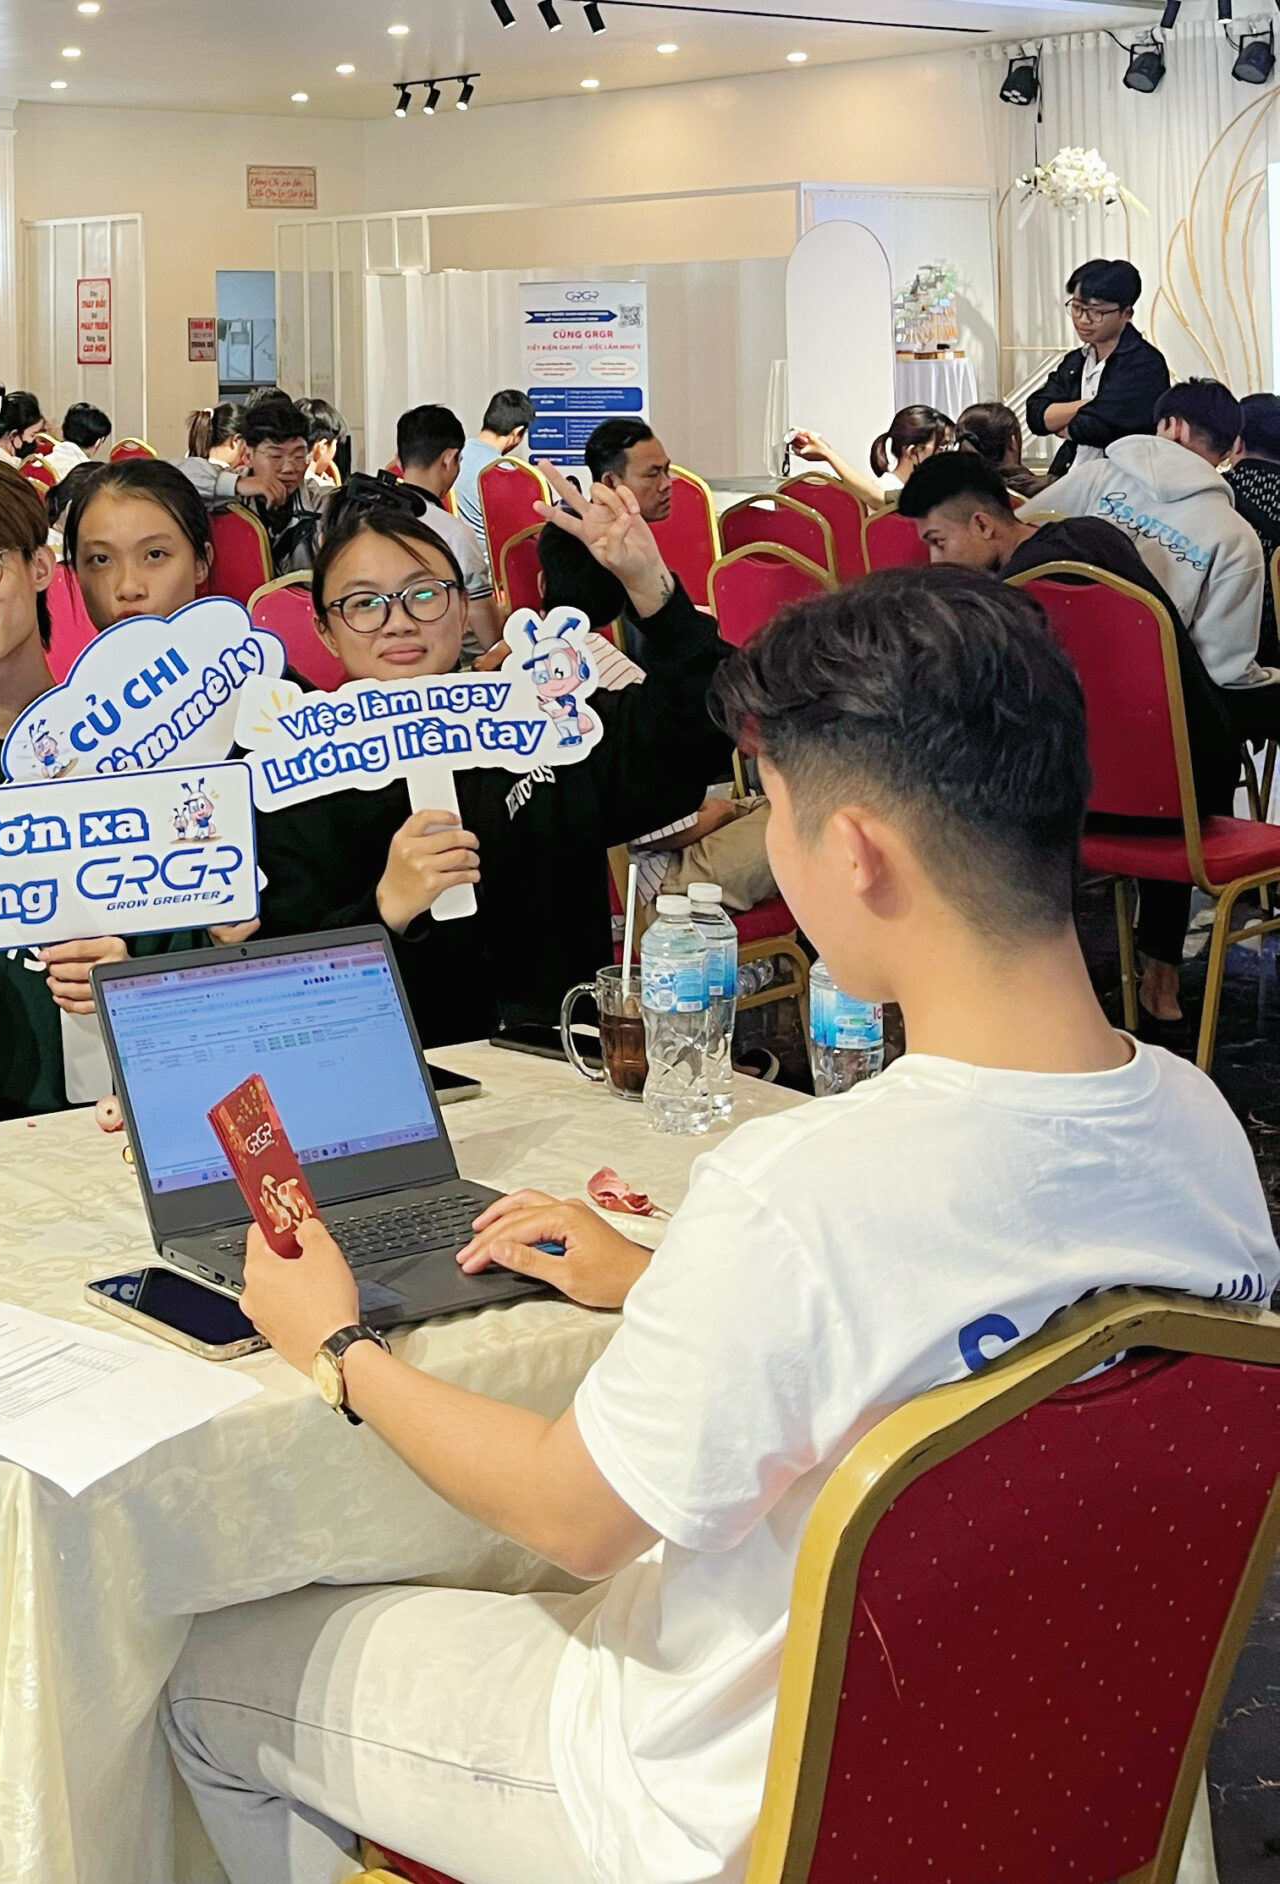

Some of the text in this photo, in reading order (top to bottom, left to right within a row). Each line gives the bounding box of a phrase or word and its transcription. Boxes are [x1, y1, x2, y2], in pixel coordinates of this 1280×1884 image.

[584, 330, 614, 339] GRGR
[69, 647, 190, 752] CỦ CHI
[278, 682, 512, 741] Việc làm ngay
[261, 716, 547, 794] Lương liền tay
[78, 807, 151, 848] xa
[76, 844, 244, 901] GRGR
[106, 890, 221, 912] GROW GREATER
